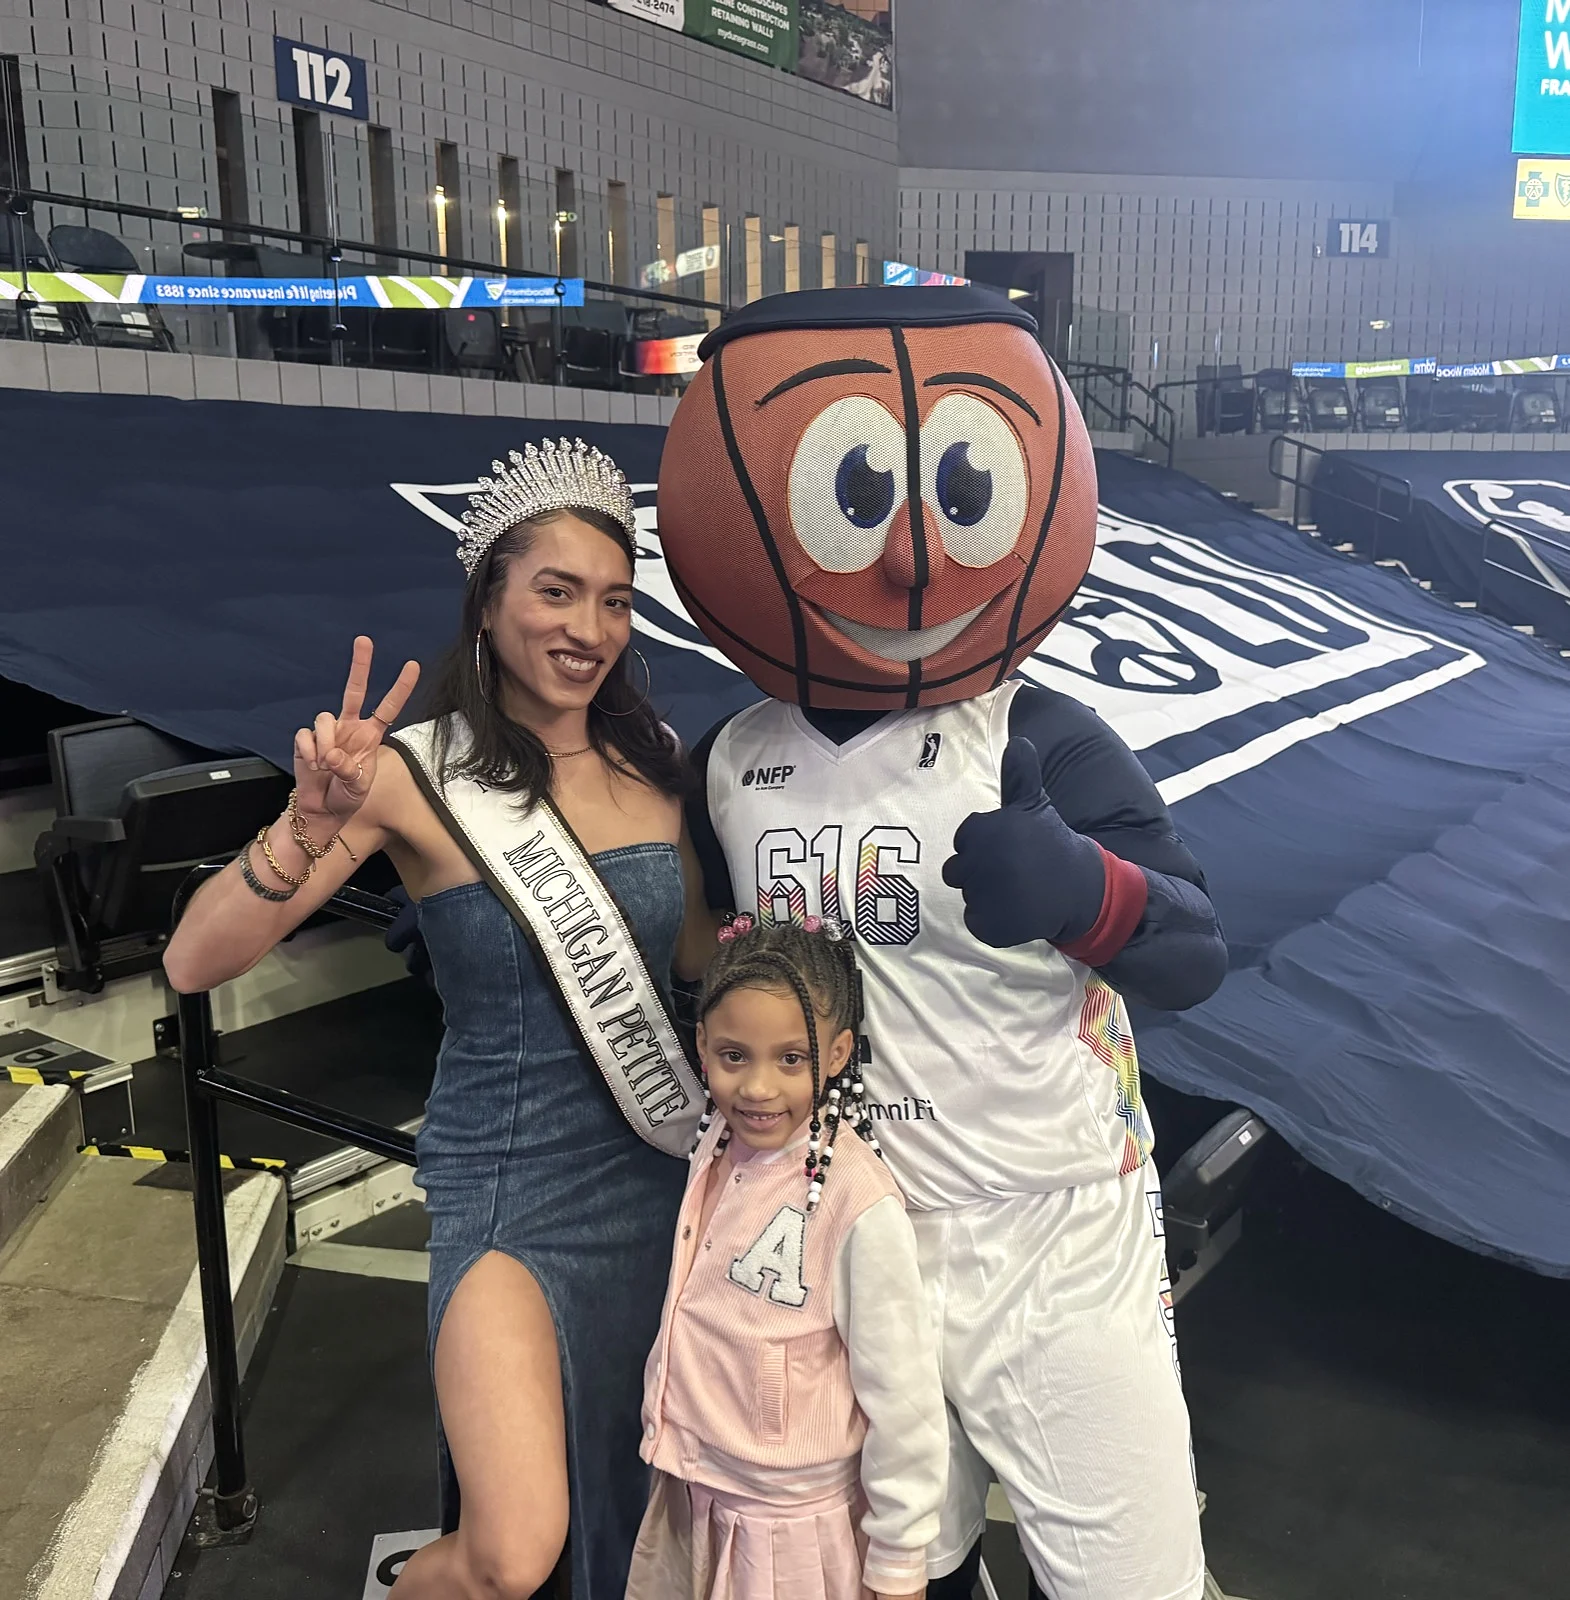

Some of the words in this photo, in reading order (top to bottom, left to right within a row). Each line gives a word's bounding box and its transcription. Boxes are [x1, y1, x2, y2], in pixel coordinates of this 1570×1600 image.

[711, 6, 750, 29] RETAINING
[751, 21, 774, 39] WALLS
[736, 2, 790, 31] CONSTRUCTION
[292, 47, 353, 111] 112
[1339, 223, 1378, 253] 114
[756, 765, 795, 785] NFP
[756, 825, 921, 945] 616
[503, 830, 633, 1010] MICHIGAN
[598, 1003, 691, 1129] PETITE
[866, 1096, 938, 1122] mniFi
[729, 1205, 808, 1307] A
